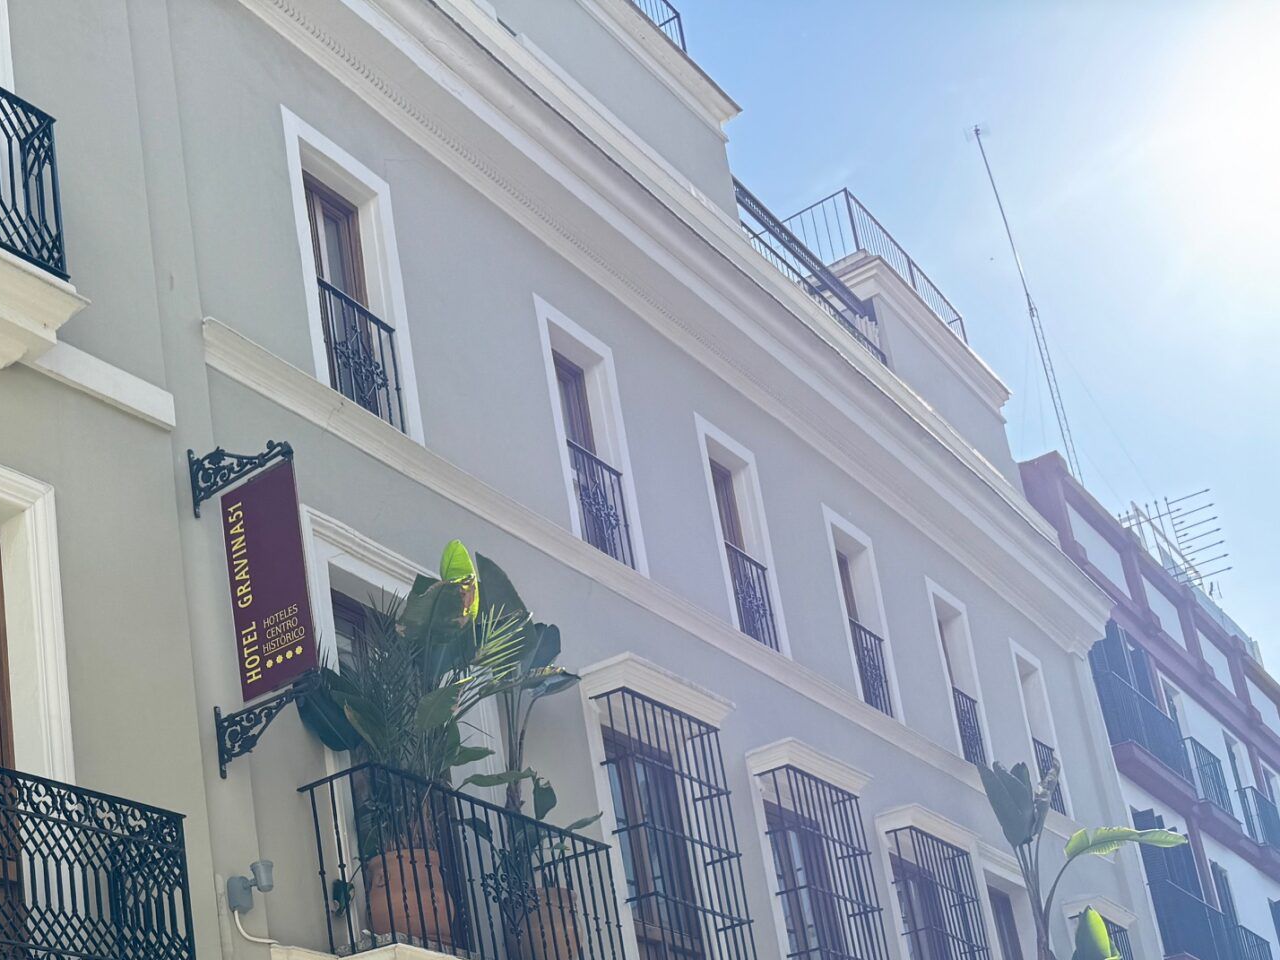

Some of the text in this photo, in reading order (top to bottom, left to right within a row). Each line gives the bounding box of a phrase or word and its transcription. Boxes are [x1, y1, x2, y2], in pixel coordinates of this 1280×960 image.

[227, 501, 262, 685] HOTEL GRAVINA51
[262, 603, 298, 628] HOTELES
[266, 616, 298, 639] CENTRO
